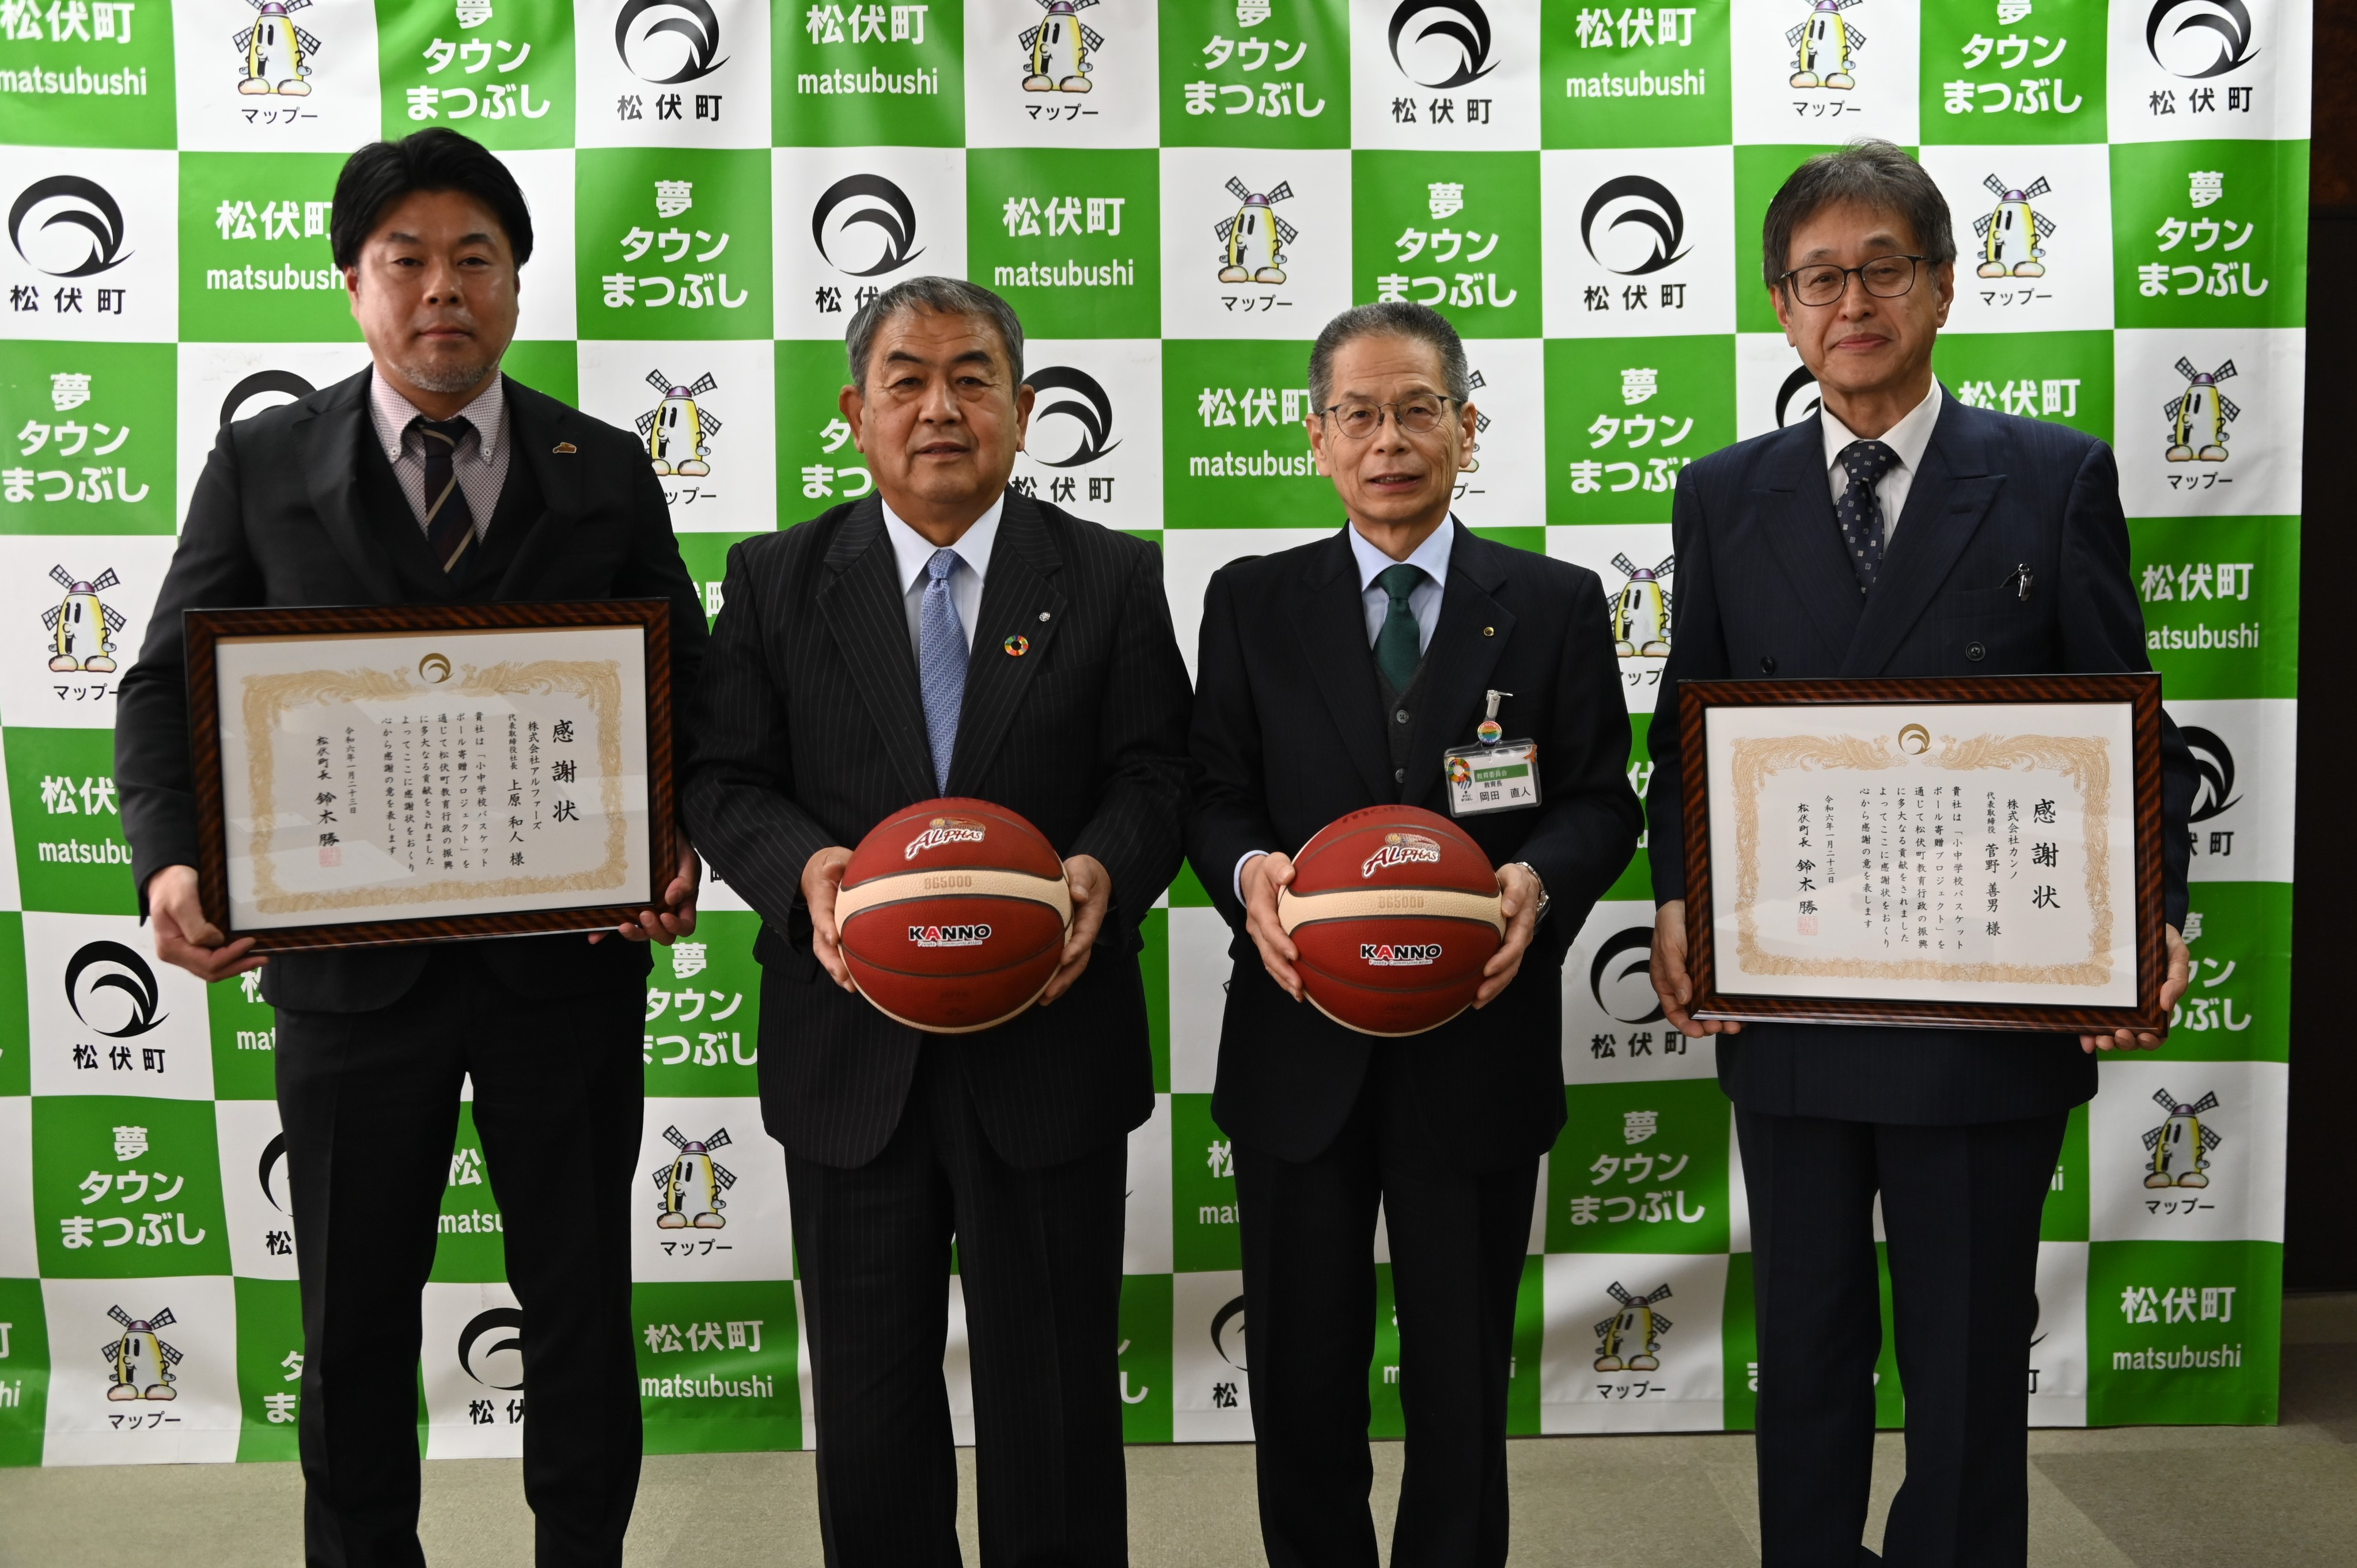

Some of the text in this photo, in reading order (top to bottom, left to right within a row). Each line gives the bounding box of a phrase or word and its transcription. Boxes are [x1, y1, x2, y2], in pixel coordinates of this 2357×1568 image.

[2, 0, 135, 44] 松伏町
[806, 4, 929, 44] 松伏町
[1576, 7, 1696, 48] 松伏町
[423, 38, 530, 74] タウン
[1203, 35, 1307, 71] タウン
[1962, 34, 2067, 69] タウン
[798, 67, 939, 94] matsubushi
[1567, 69, 1705, 97] matsubushi
[1944, 78, 2082, 114] まつぶし
[242, 107, 317, 124] マップー
[407, 84, 551, 120] まつぶし
[617, 94, 722, 122] 松伏町
[1025, 104, 1098, 120] マップー
[1184, 81, 1325, 117] まつぶし
[1392, 97, 1492, 124] 松伏町
[1793, 101, 1860, 116] マップー
[2150, 87, 2253, 115] 松伏町
[655, 180, 692, 218] 夢
[1428, 183, 1464, 219] 夢
[2189, 171, 2224, 208] 夢
[1003, 196, 1125, 237] 松伏町
[620, 227, 730, 262] タウン
[1396, 228, 1499, 263] タウン
[2156, 217, 2254, 252] タウン
[207, 263, 344, 292] matsubush
[995, 259, 1134, 286] matsubushi
[2138, 262, 2269, 297] まつぶし
[10, 285, 126, 314] 松伏町
[602, 273, 749, 309] まつぶし
[1222, 295, 1292, 312] マップー
[1377, 274, 1518, 307] まつぶし
[1584, 284, 1686, 311] 松伏町
[1980, 288, 2052, 306] マップー
[51, 373, 91, 411] 夢
[1621, 368, 1658, 405] 夢
[18, 420, 130, 456] タウン
[1588, 414, 1693, 449] タウン
[1189, 450, 1315, 478] matsubush
[1570, 458, 1688, 494] まつぶ
[2167, 472, 2233, 489] マップー
[1, 466, 149, 503] まつぶし
[665, 487, 717, 504] ップー
[2140, 563, 2253, 602] 松伏町
[2147, 622, 2260, 650] atsubushi
[316, 735, 332, 781] 松伏町長
[528, 721, 542, 830] 株式会社アルファーズ
[551, 719, 579, 823] 感謝状
[1476, 769, 1507, 779] 教育委員会
[40, 775, 118, 817] 松伏
[507, 779, 522, 807] 上原
[1480, 787, 1531, 803] 岡田 直人
[1484, 780, 1503, 788] 教育長
[315, 792, 338, 825] 鈴木
[1797, 803, 1812, 848] 松伏町長
[508, 815, 524, 843] 和人
[1825, 795, 1836, 883] 令和六年一月二十三日
[2007, 799, 2019, 879] 株式会社カンノ
[38, 838, 132, 866] matsubu
[509, 851, 525, 866] 様
[1362, 846, 1439, 878] ALPHAS
[1859, 788, 1873, 929] 心から感謝の意を表します
[1985, 791, 2002, 937] 代表取締役 菅野 善男 様
[2031, 798, 2061, 909] 感謝状
[1795, 859, 1817, 891] 鈴木
[1798, 900, 1818, 915] 勝
[909, 924, 991, 941] KANNO
[671, 941, 707, 979] 夢
[1361, 944, 1442, 959] KANNO
[73, 1045, 165, 1073] 松伏町
[113, 1126, 149, 1161] 夢
[1624, 1110, 1659, 1145] 夢
[1590, 1152, 1689, 1186] タウン
[79, 1170, 184, 1205] タウン
[1571, 1190, 1706, 1225] まつぶし
[2145, 1198, 2214, 1214] マップー
[60, 1212, 206, 1249] まつぶし
[661, 1239, 732, 1256] マップー
[2121, 1286, 2237, 1324] 松伏町
[644, 1320, 763, 1353] 松伏町
[2113, 1343, 2242, 1370] matsubushi
[641, 1375, 773, 1399] matsubushi
[1597, 1381, 1665, 1399] マップー
[109, 1411, 180, 1429] マップー
